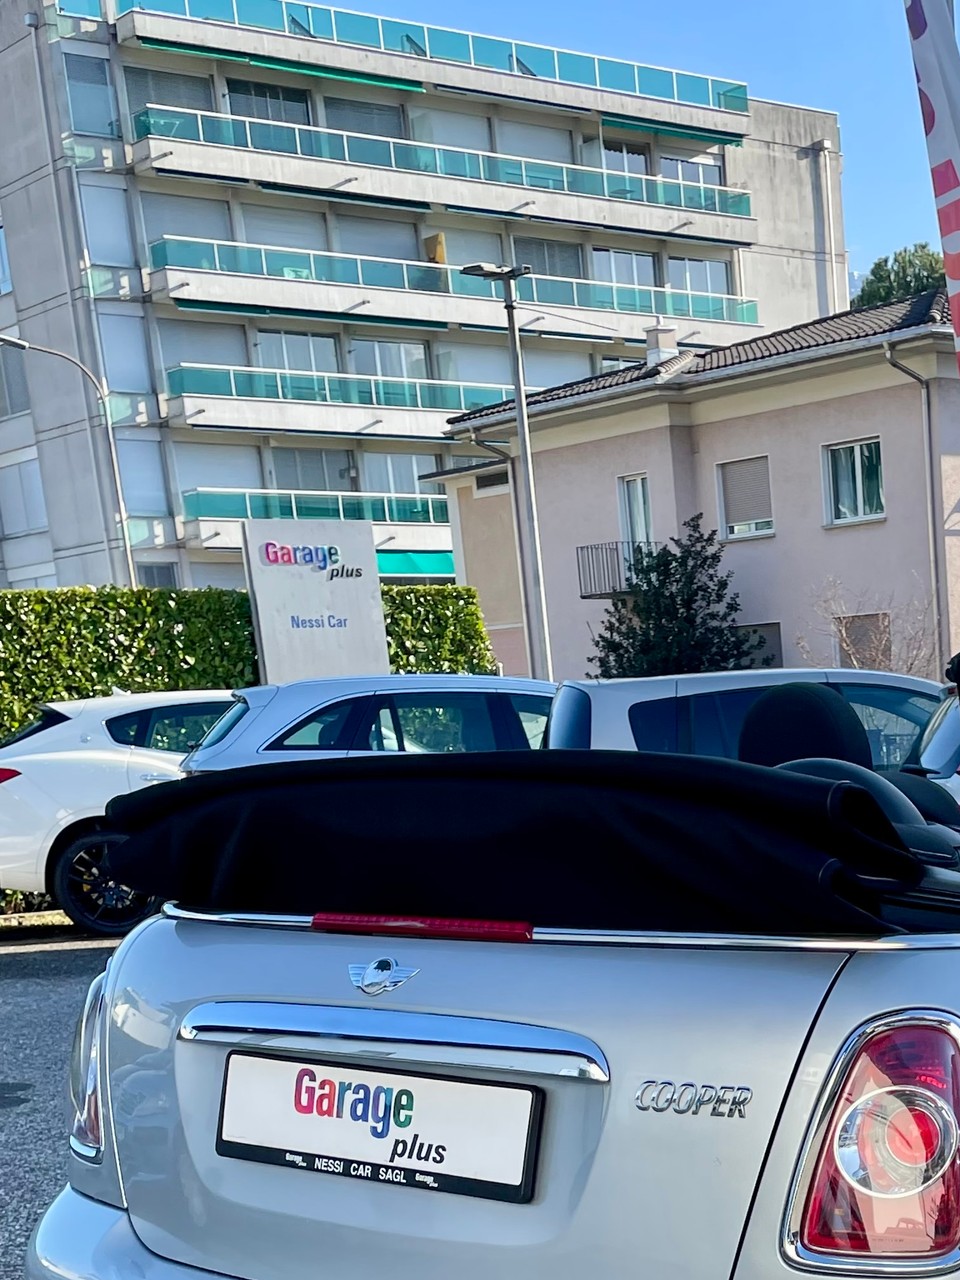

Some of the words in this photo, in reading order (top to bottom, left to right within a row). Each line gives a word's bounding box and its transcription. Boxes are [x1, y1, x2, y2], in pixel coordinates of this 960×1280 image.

[265, 542, 339, 570] Garage
[329, 565, 363, 581] plus
[290, 615, 325, 629] Nessi
[327, 615, 348, 628] Car
[294, 1068, 414, 1139] Garage
[635, 1080, 753, 1119] COOPER
[389, 1134, 447, 1164] plus
[314, 1157, 344, 1173] NESSI
[350, 1163, 372, 1178] CAR
[378, 1167, 407, 1184] SAGL
